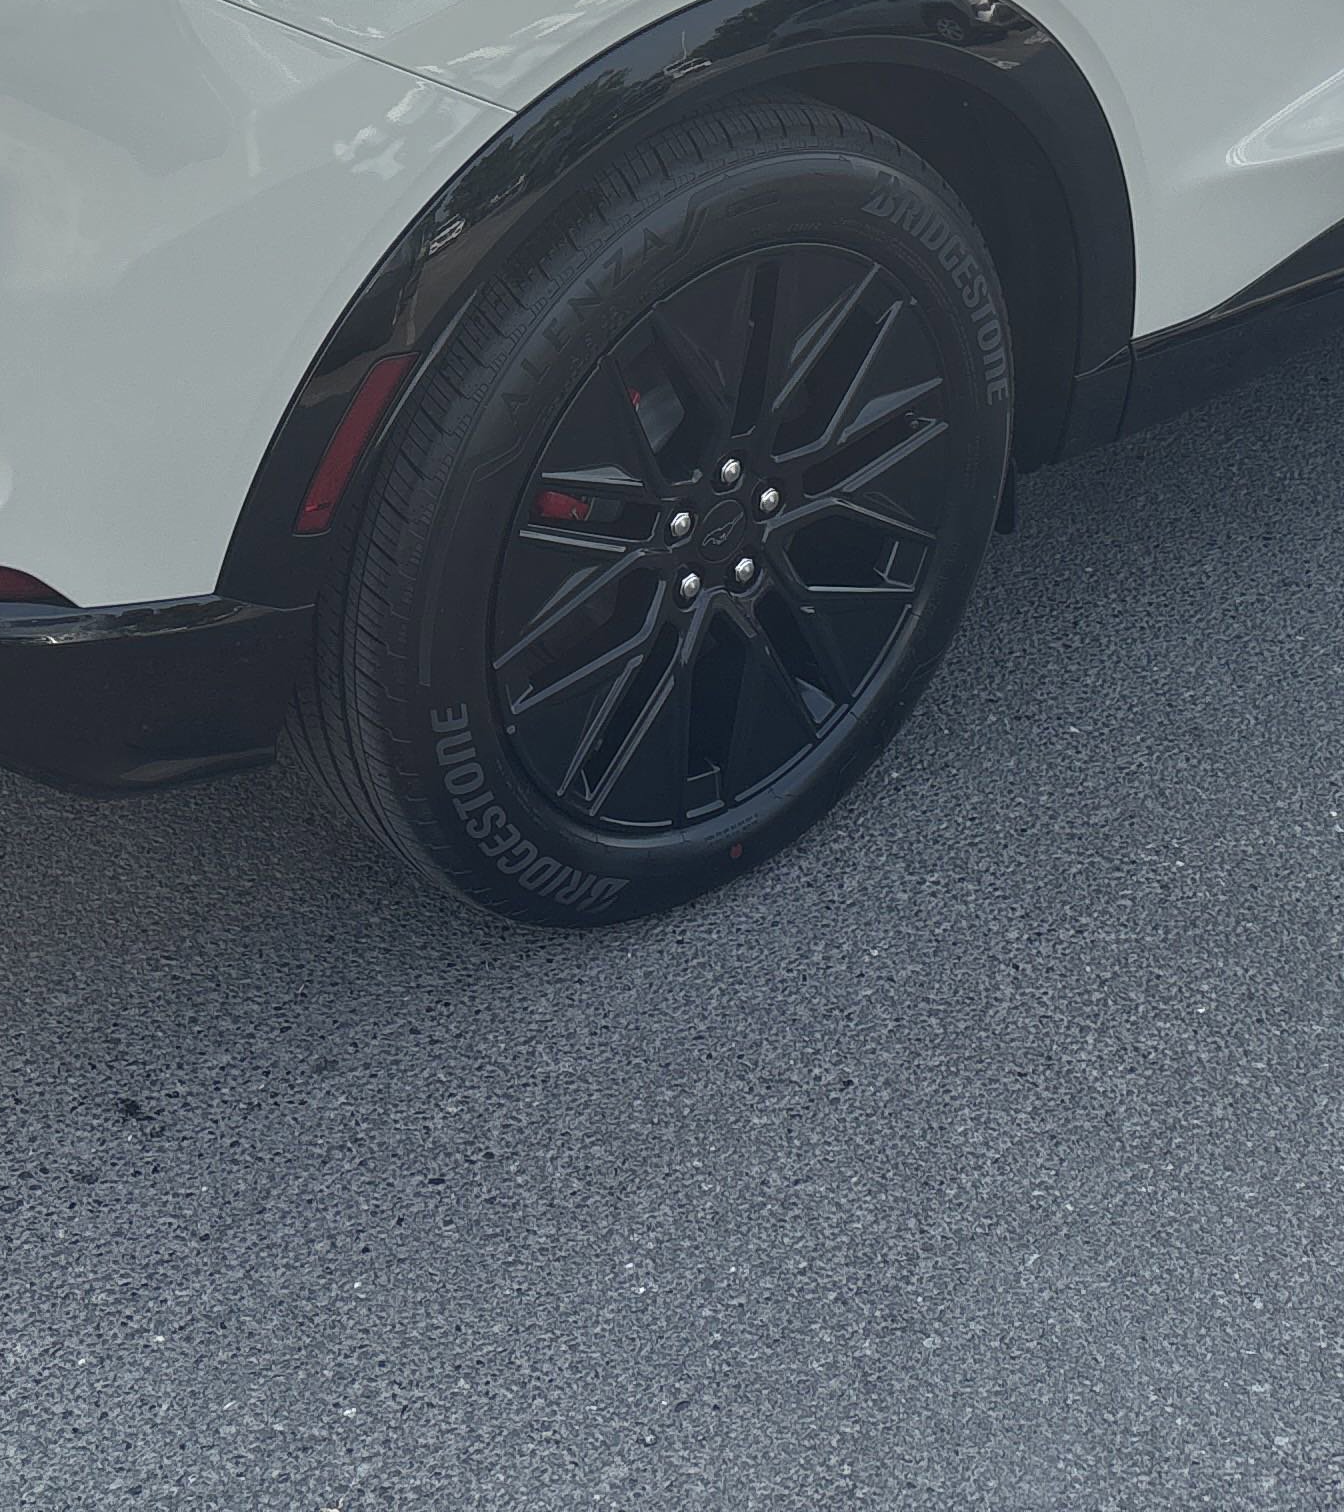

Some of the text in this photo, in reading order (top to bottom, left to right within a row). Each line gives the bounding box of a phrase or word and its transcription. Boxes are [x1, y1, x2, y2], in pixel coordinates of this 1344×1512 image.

[500, 226, 674, 428] ALENZA
[860, 171, 1011, 406] BRIDGESTONE
[430, 703, 631, 913] BRIDGESTONE
